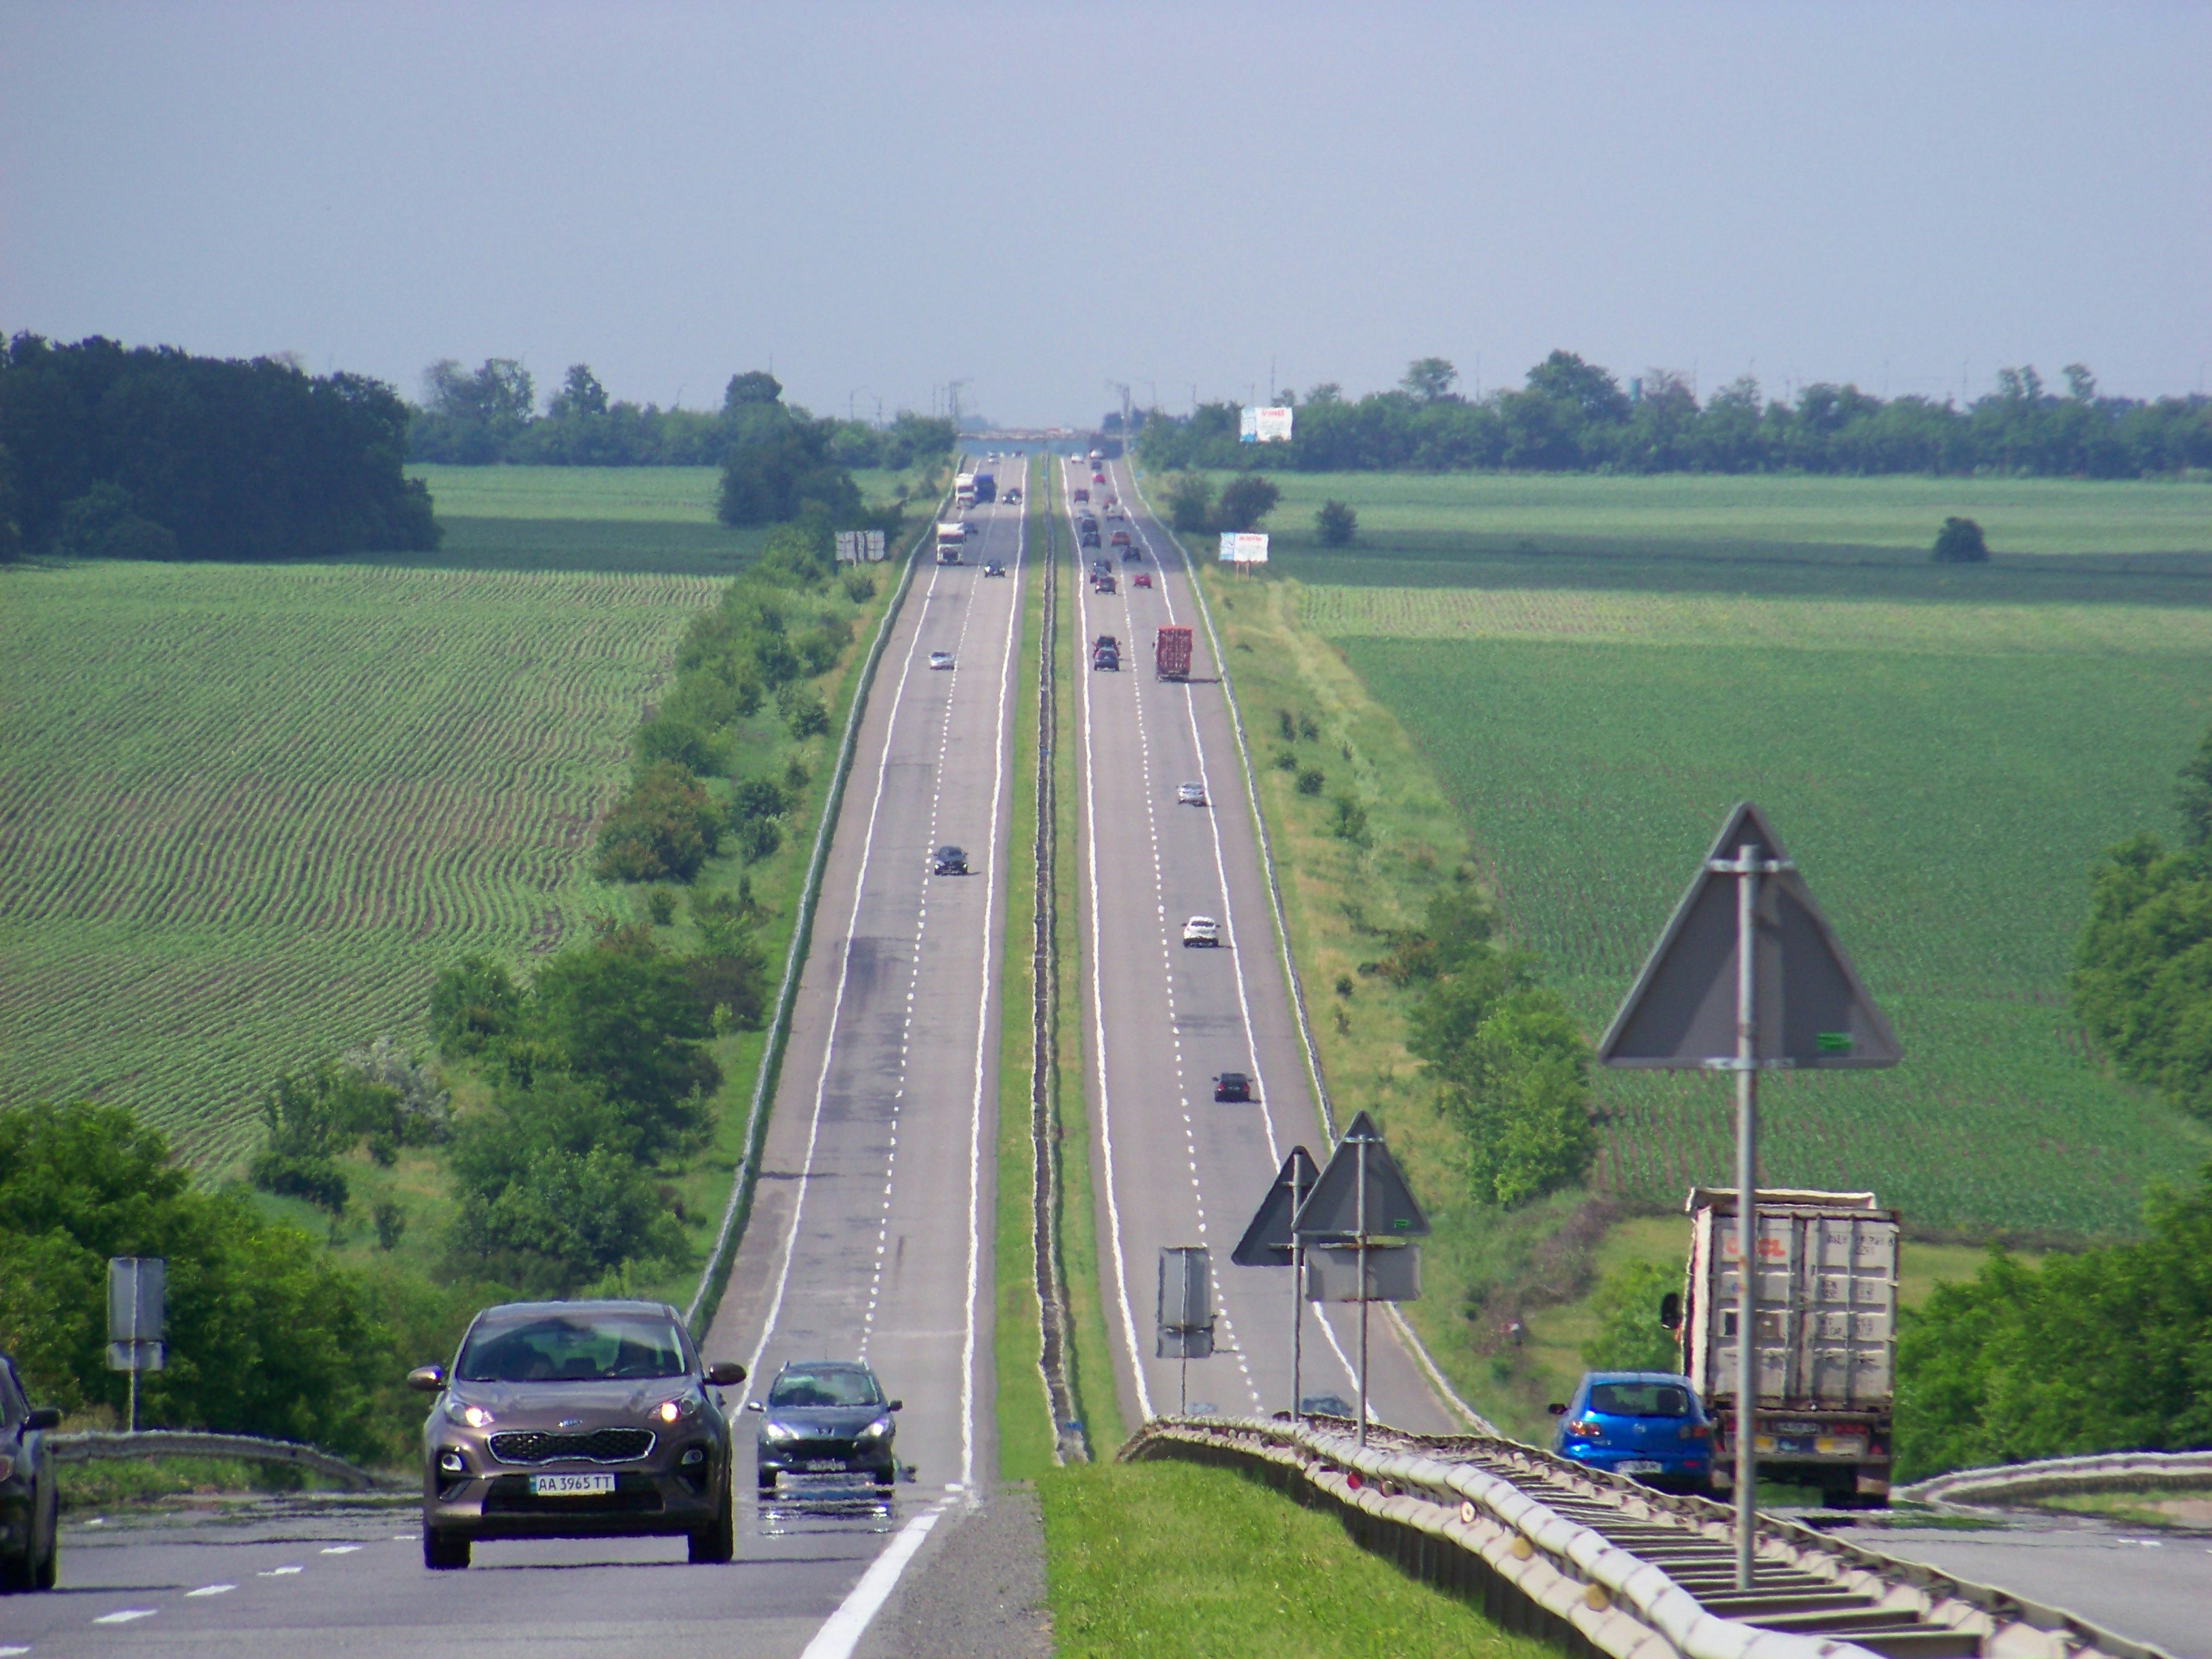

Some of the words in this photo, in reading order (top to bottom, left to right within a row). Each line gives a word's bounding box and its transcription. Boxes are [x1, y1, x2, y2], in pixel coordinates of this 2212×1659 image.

[1725, 1237, 1786, 1258] OCL
[538, 1478, 556, 1491] AA
[560, 1477, 591, 1490] 3965
[594, 1477, 611, 1489] TT
